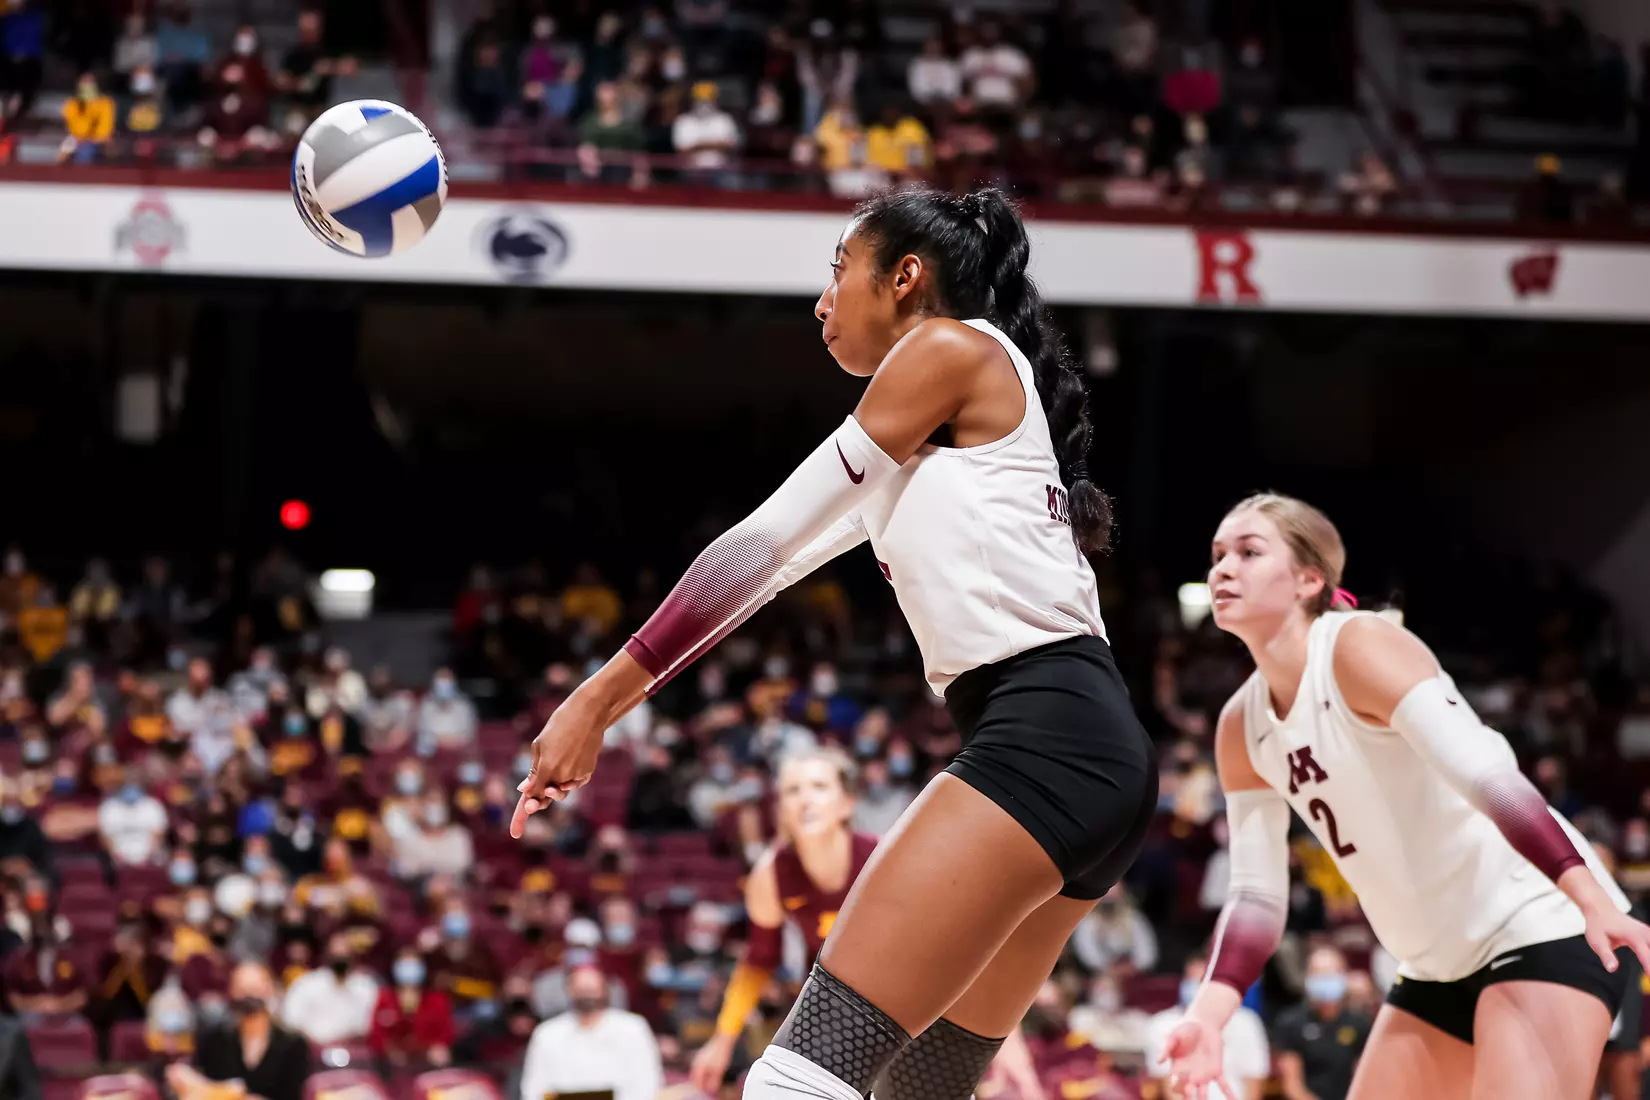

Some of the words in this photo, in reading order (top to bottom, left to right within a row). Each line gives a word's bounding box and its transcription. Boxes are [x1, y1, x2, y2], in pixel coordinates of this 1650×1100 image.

[1193, 229, 1261, 303] R
[1287, 745, 1328, 794] M
[1309, 798, 1357, 858] 2
